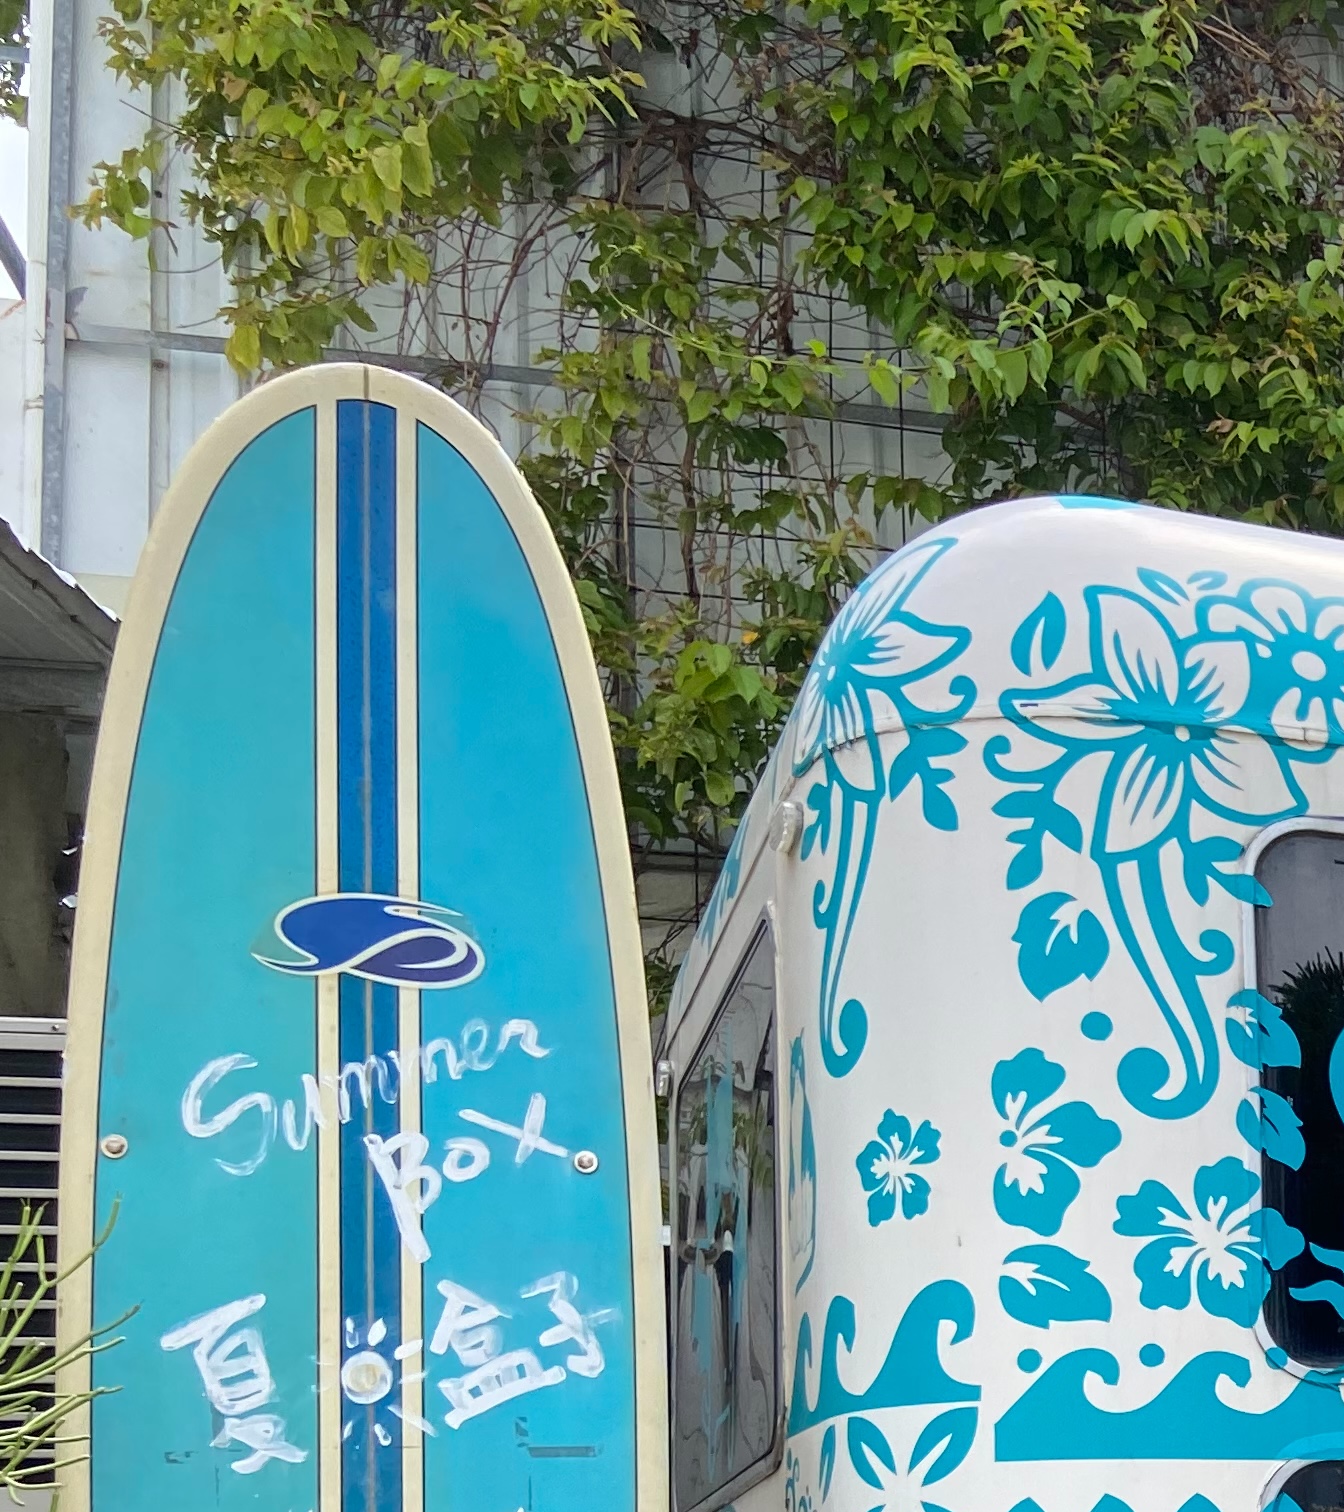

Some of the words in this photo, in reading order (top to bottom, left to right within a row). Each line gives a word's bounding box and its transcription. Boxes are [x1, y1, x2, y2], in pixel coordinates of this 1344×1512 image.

[181, 1018, 551, 1177] Summer
[160, 1293, 307, 1475] 夏
[430, 1271, 618, 1430] 盒子
